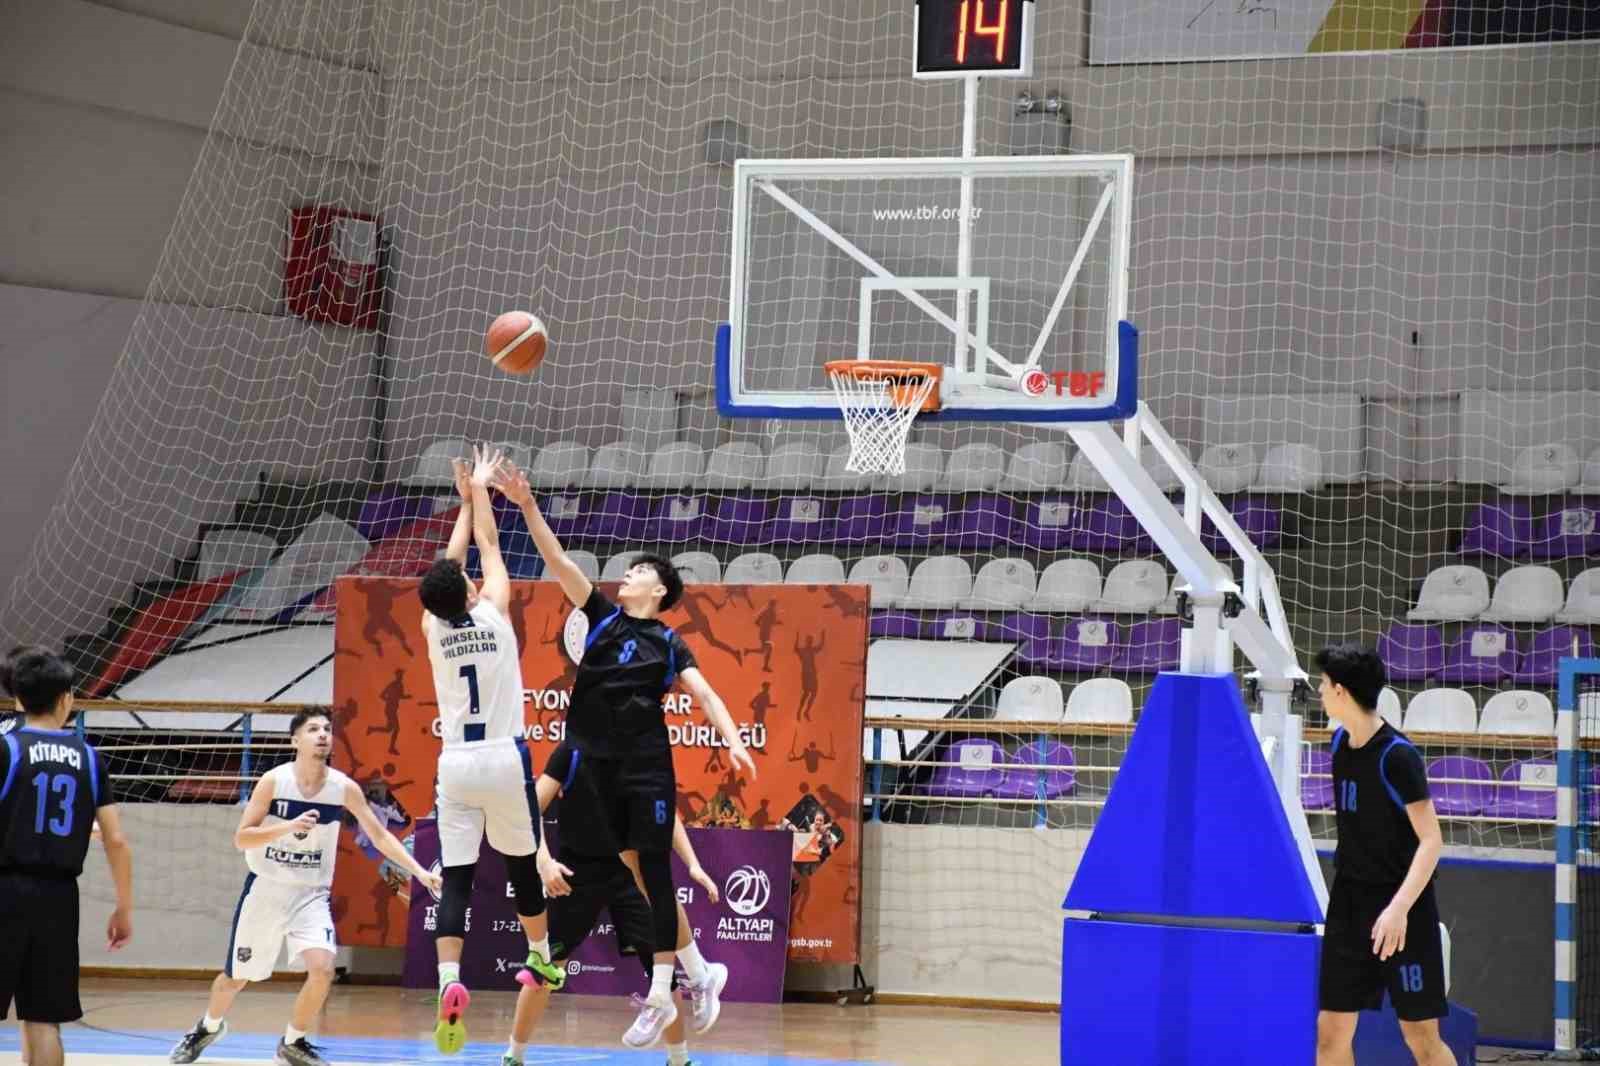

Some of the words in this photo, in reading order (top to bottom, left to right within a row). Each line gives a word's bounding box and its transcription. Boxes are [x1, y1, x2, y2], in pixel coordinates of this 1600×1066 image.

[956, 0, 1008, 64] 14
[1050, 369, 1105, 398] TBF
[459, 664, 480, 715] 1
[31, 771, 77, 837] 13
[1340, 778, 1358, 813] 18
[655, 799, 668, 825] 6
[717, 917, 774, 932] ALTYAPI
[1399, 963, 1424, 993] 18
